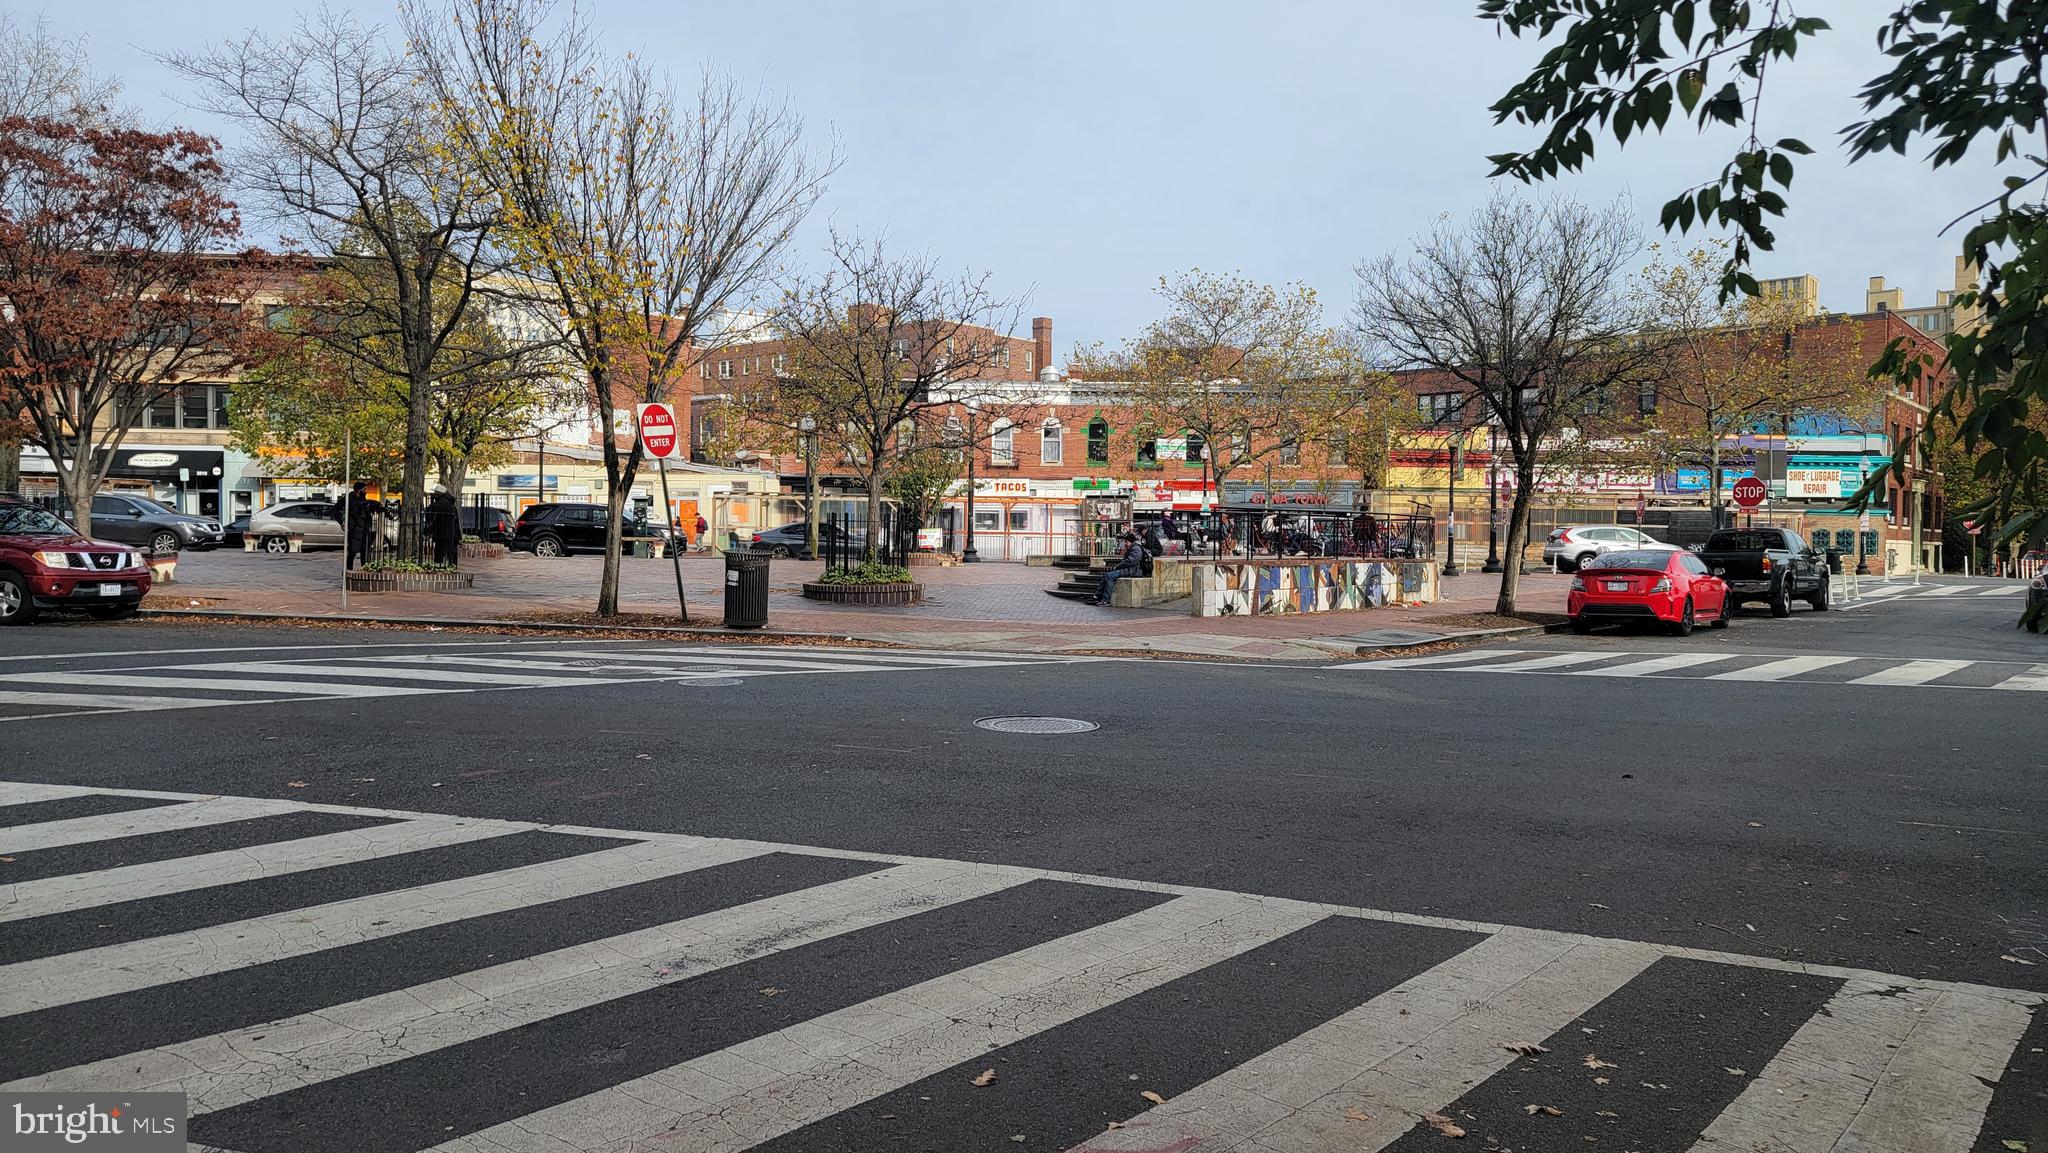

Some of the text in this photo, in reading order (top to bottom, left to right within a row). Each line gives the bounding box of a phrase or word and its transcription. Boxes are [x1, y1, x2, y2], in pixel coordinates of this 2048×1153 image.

[644, 414, 669, 424] DO NOT
[650, 438, 670, 448] ENTER
[1788, 471, 1806, 481] SHOE
[1810, 471, 1840, 481] LUGGAGE
[994, 483, 1027, 493] TACOS
[1734, 486, 1764, 498] STOP
[1803, 484, 1827, 494] REPAIR
